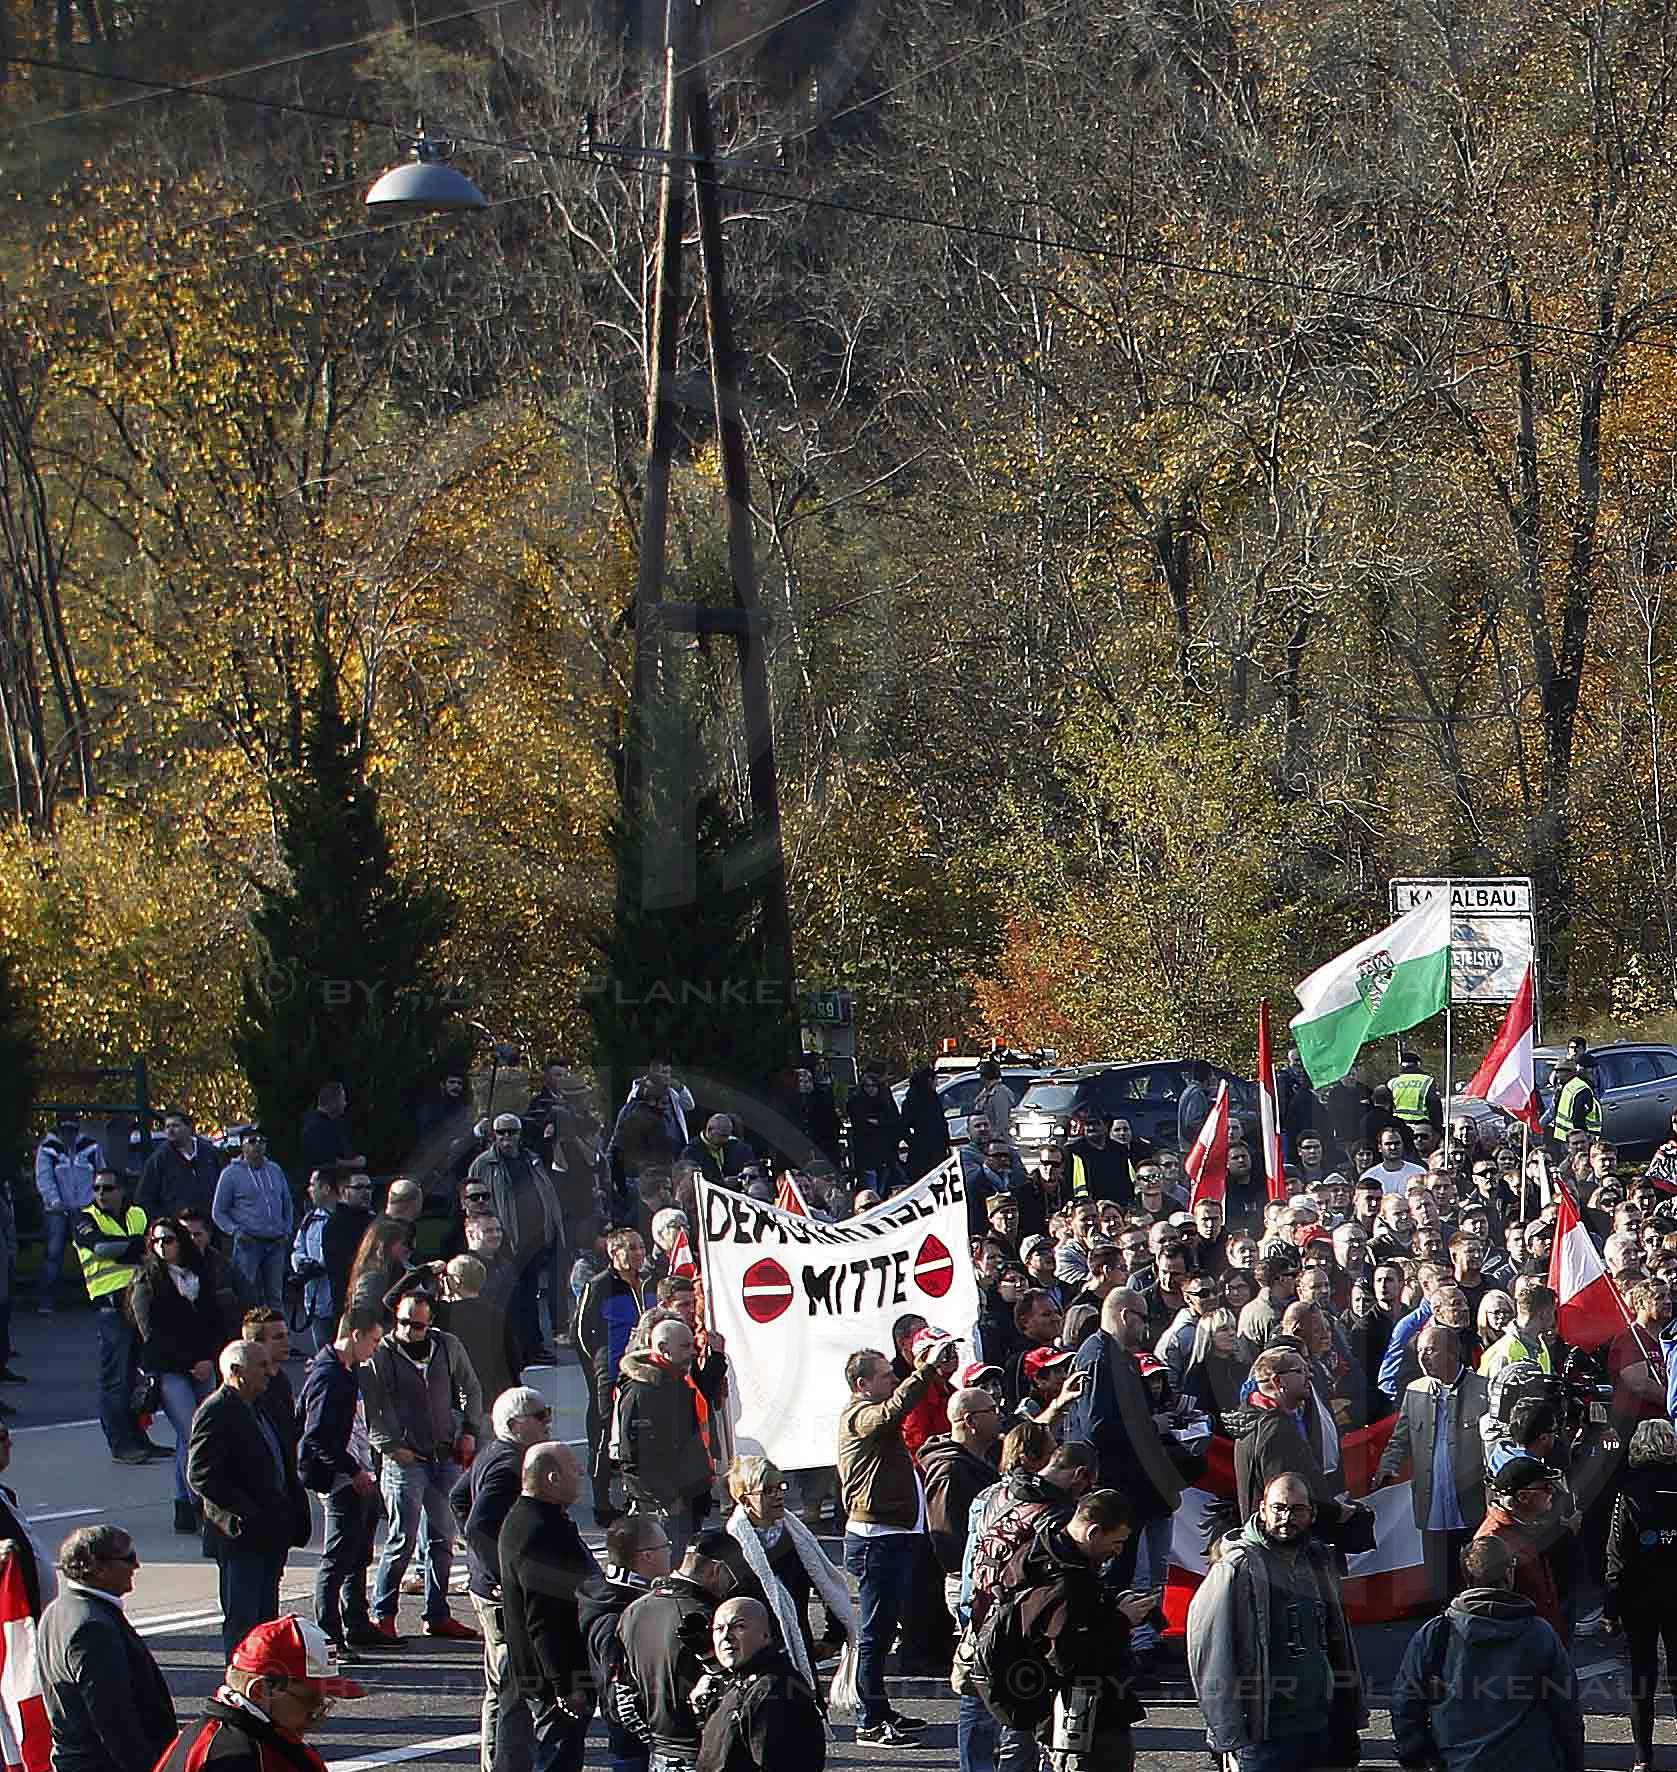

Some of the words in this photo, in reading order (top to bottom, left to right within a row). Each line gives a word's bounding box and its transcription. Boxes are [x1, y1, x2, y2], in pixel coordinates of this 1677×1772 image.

[1410, 890, 1516, 907] KAALBAU
[1451, 950, 1501, 967] ETELSKY
[802, 1250, 909, 1316] MITTE
